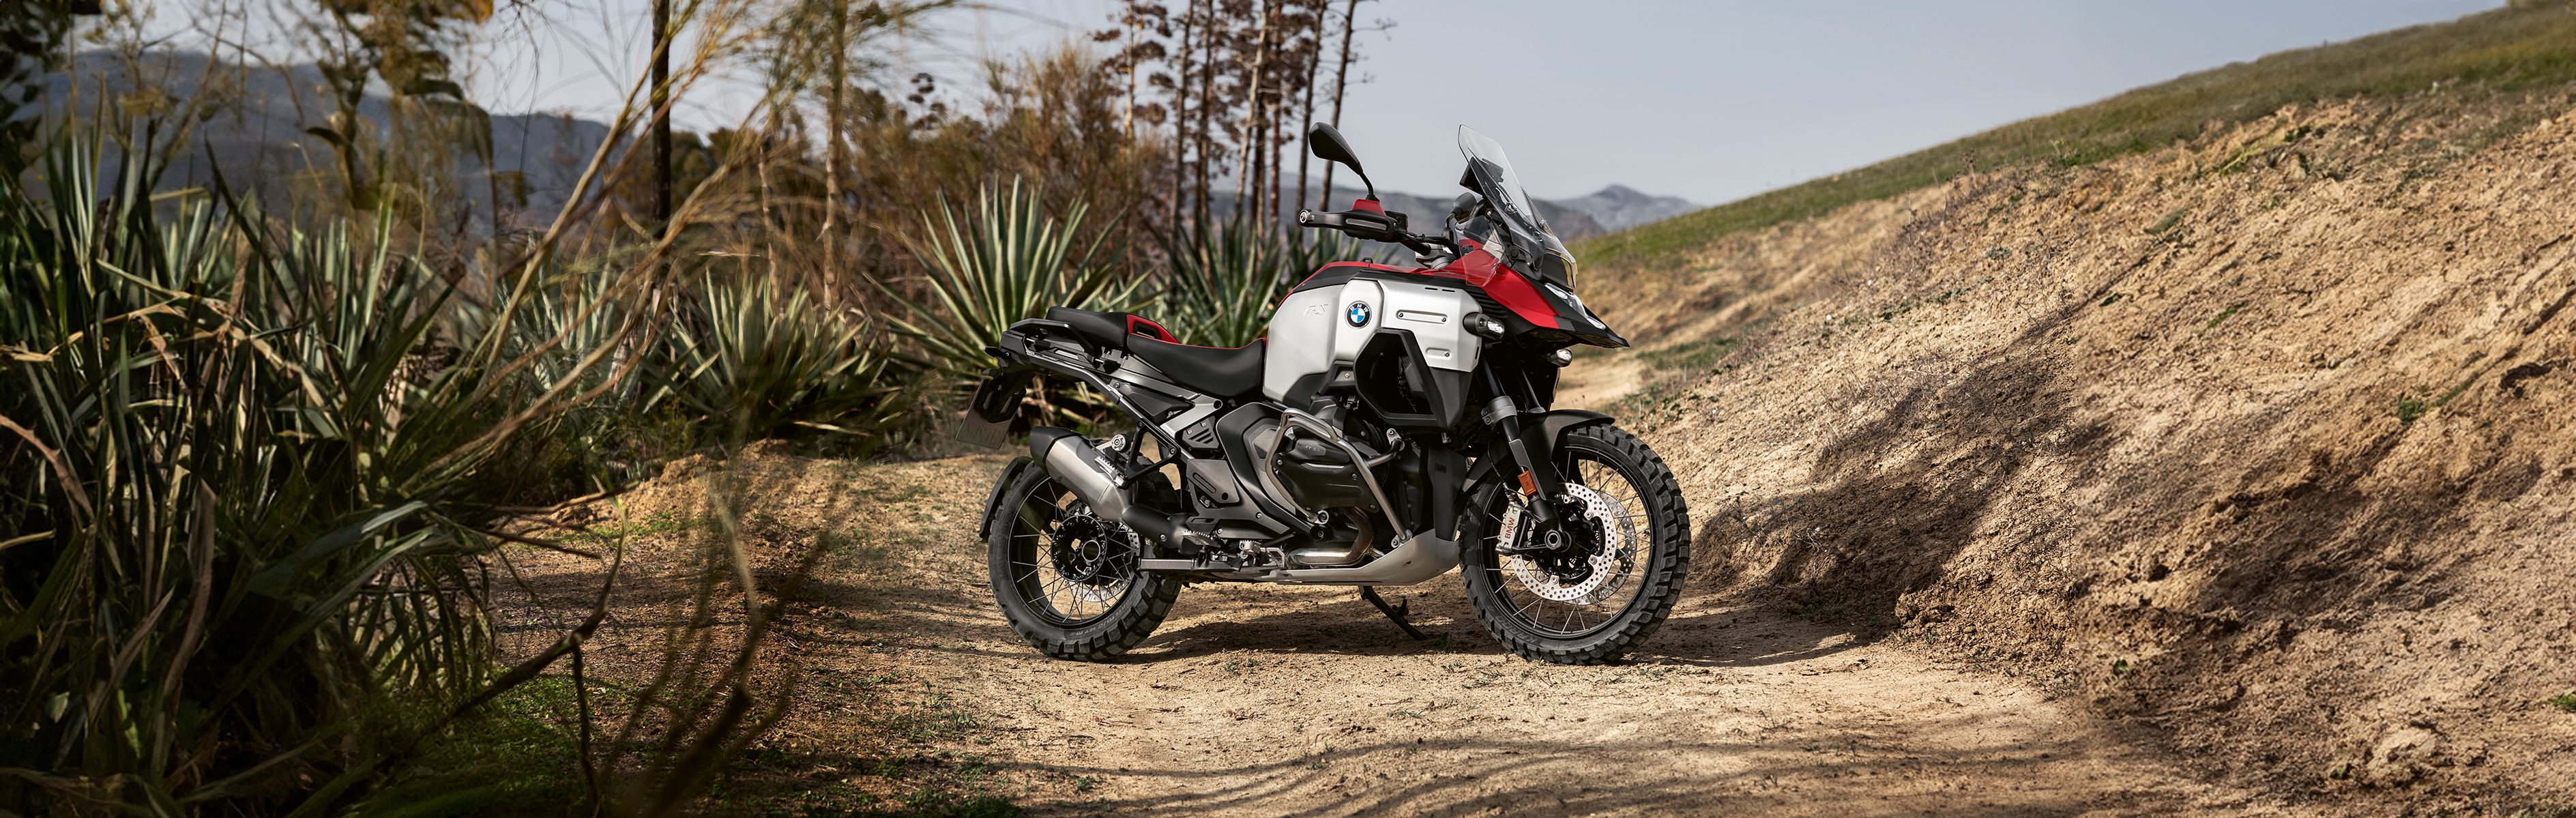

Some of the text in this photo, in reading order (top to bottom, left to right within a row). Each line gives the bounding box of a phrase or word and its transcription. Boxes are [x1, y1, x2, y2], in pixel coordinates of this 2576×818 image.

[1350, 304, 1368, 312] BMW
[1434, 463, 1447, 473] BMW
[1504, 516, 1515, 539] BMW
[1495, 615, 1538, 643] KAROO
